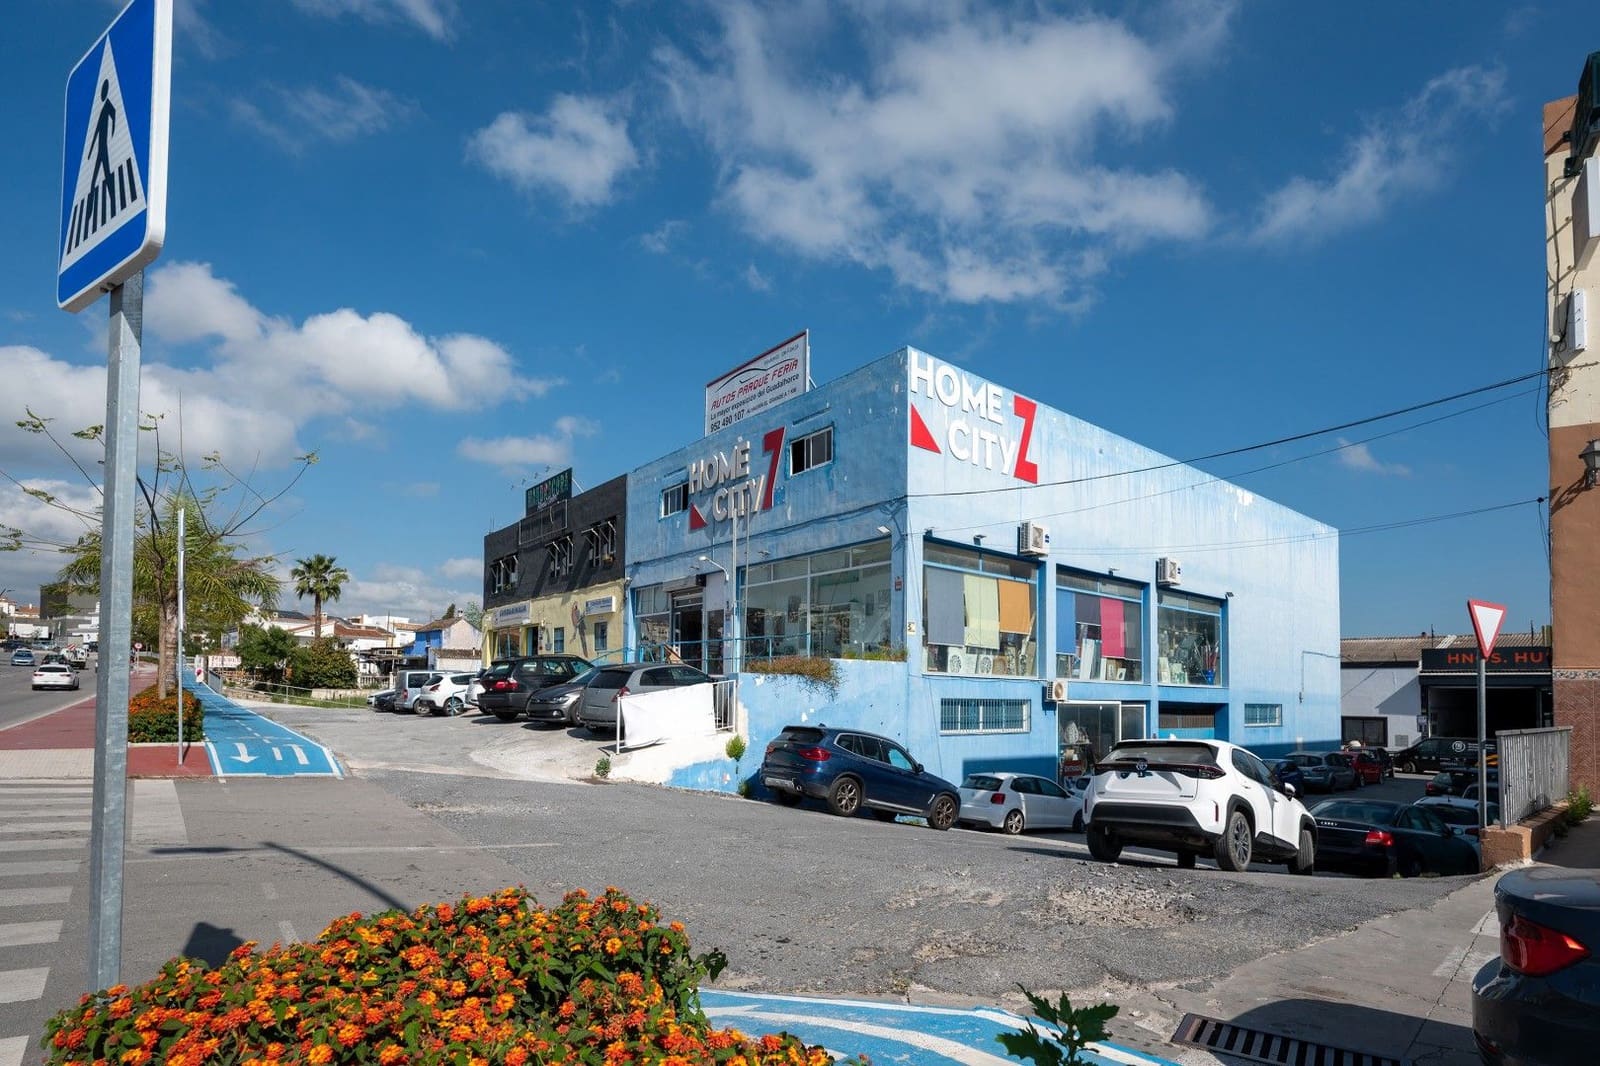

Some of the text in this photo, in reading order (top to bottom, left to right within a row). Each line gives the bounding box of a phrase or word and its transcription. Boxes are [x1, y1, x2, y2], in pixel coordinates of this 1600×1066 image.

[711, 391, 736, 411] AUTOS
[737, 373, 770, 397] PARQUE
[771, 360, 799, 381] FERIA
[910, 351, 1004, 425] HOME
[688, 440, 750, 494] HOME
[948, 419, 1017, 476] CITY
[712, 474, 766, 522] CITY
[1447, 652, 1508, 665] HNS.
